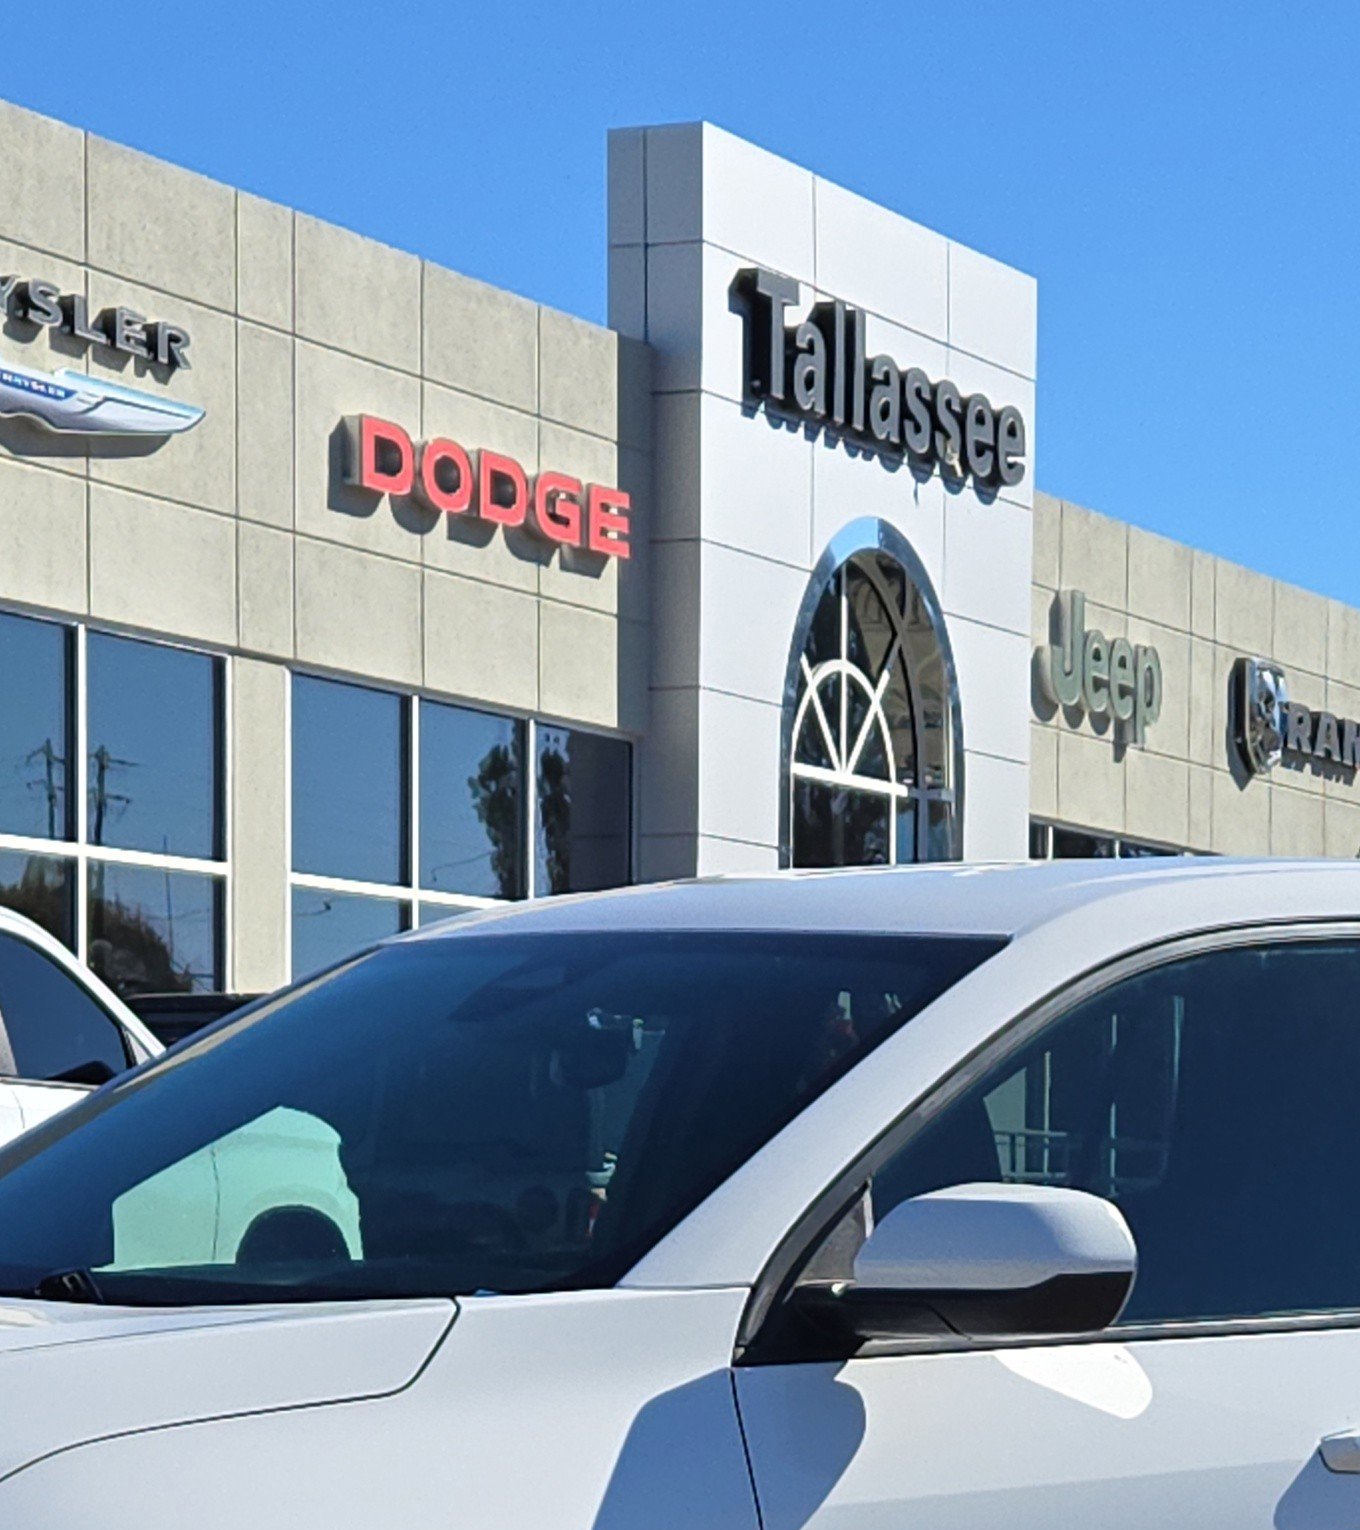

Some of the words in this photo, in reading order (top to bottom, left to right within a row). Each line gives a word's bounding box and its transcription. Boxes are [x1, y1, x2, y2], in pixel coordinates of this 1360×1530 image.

[748, 268, 1027, 488] Tallassee
[356, 413, 631, 559] DODGE
[1046, 589, 1162, 747] Jeep
